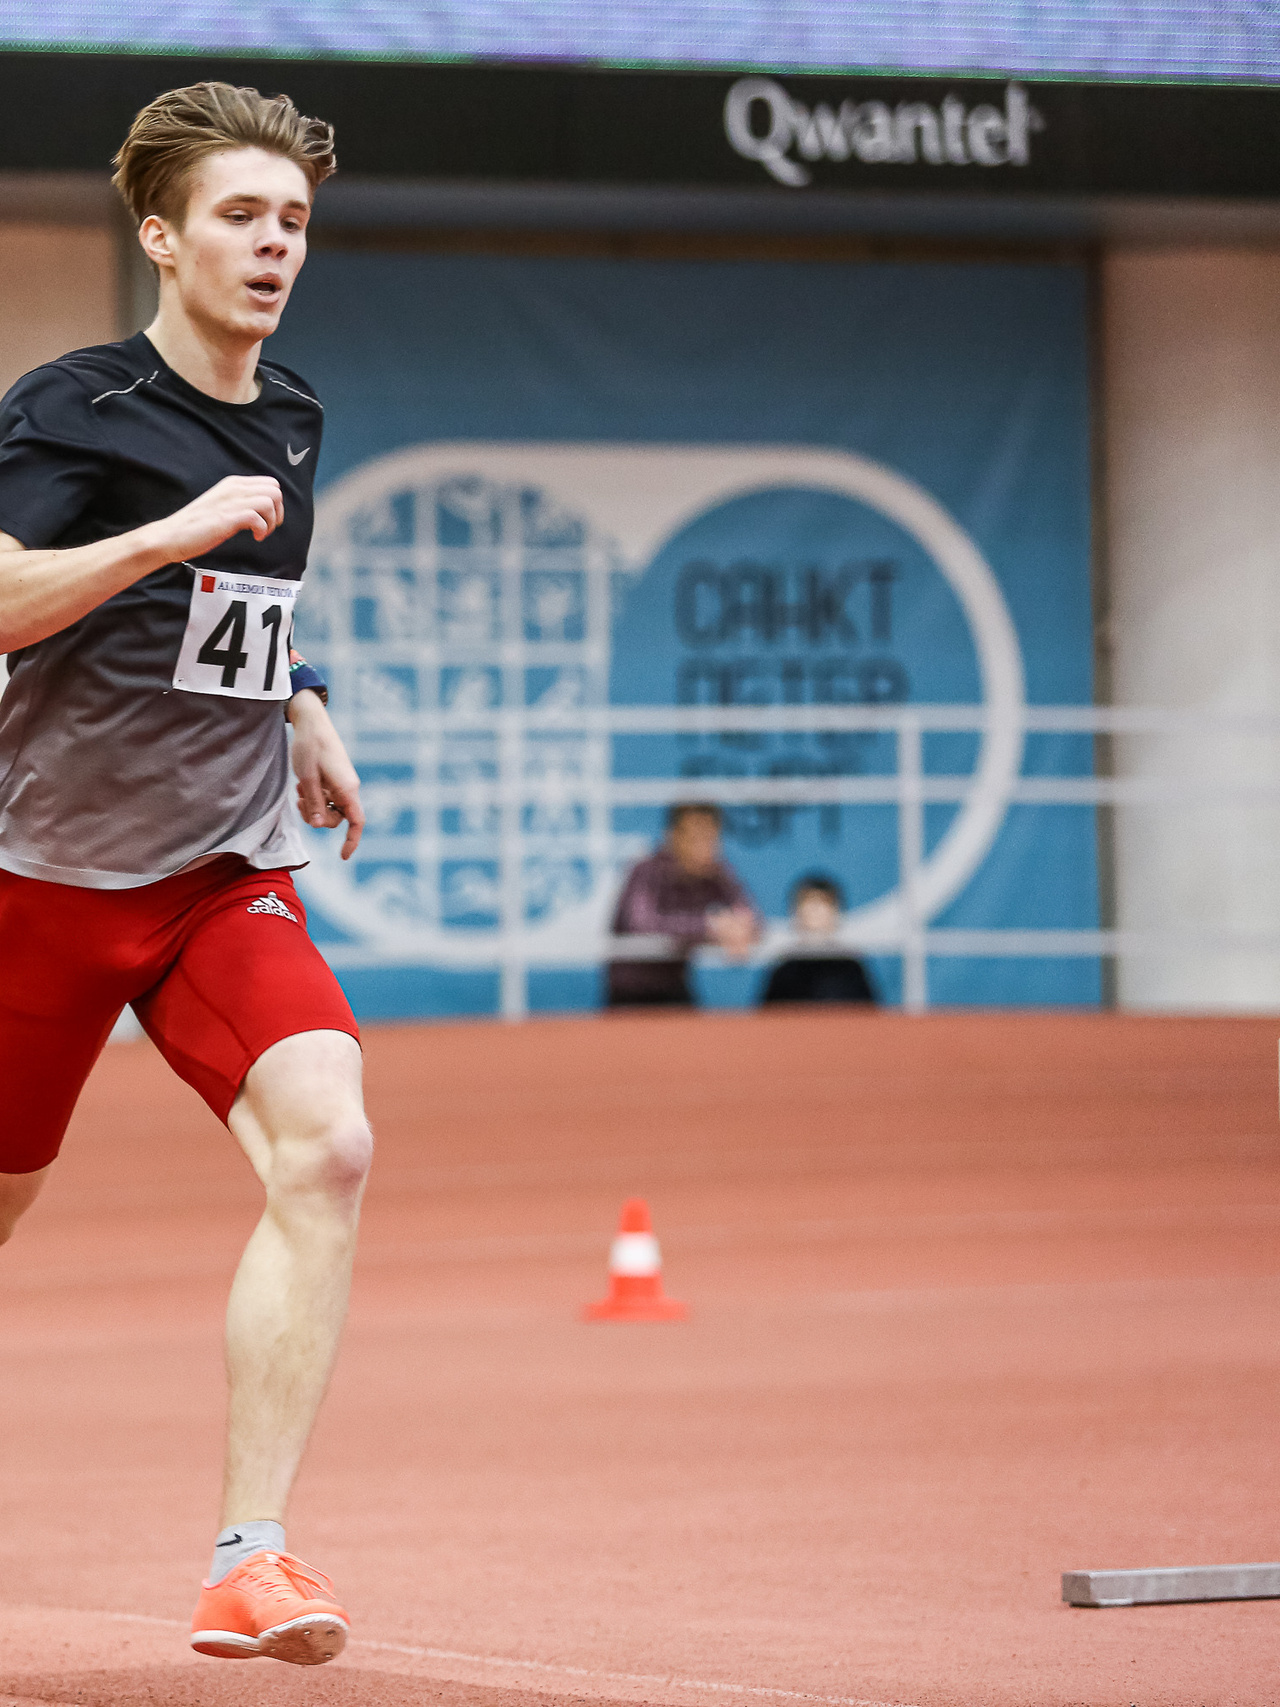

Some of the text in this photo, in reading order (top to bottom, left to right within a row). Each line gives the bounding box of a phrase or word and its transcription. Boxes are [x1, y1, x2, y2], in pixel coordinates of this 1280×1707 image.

[723, 76, 1032, 187] Qwantel
[196, 600, 293, 691] 41
[246, 906, 298, 923] adidas
